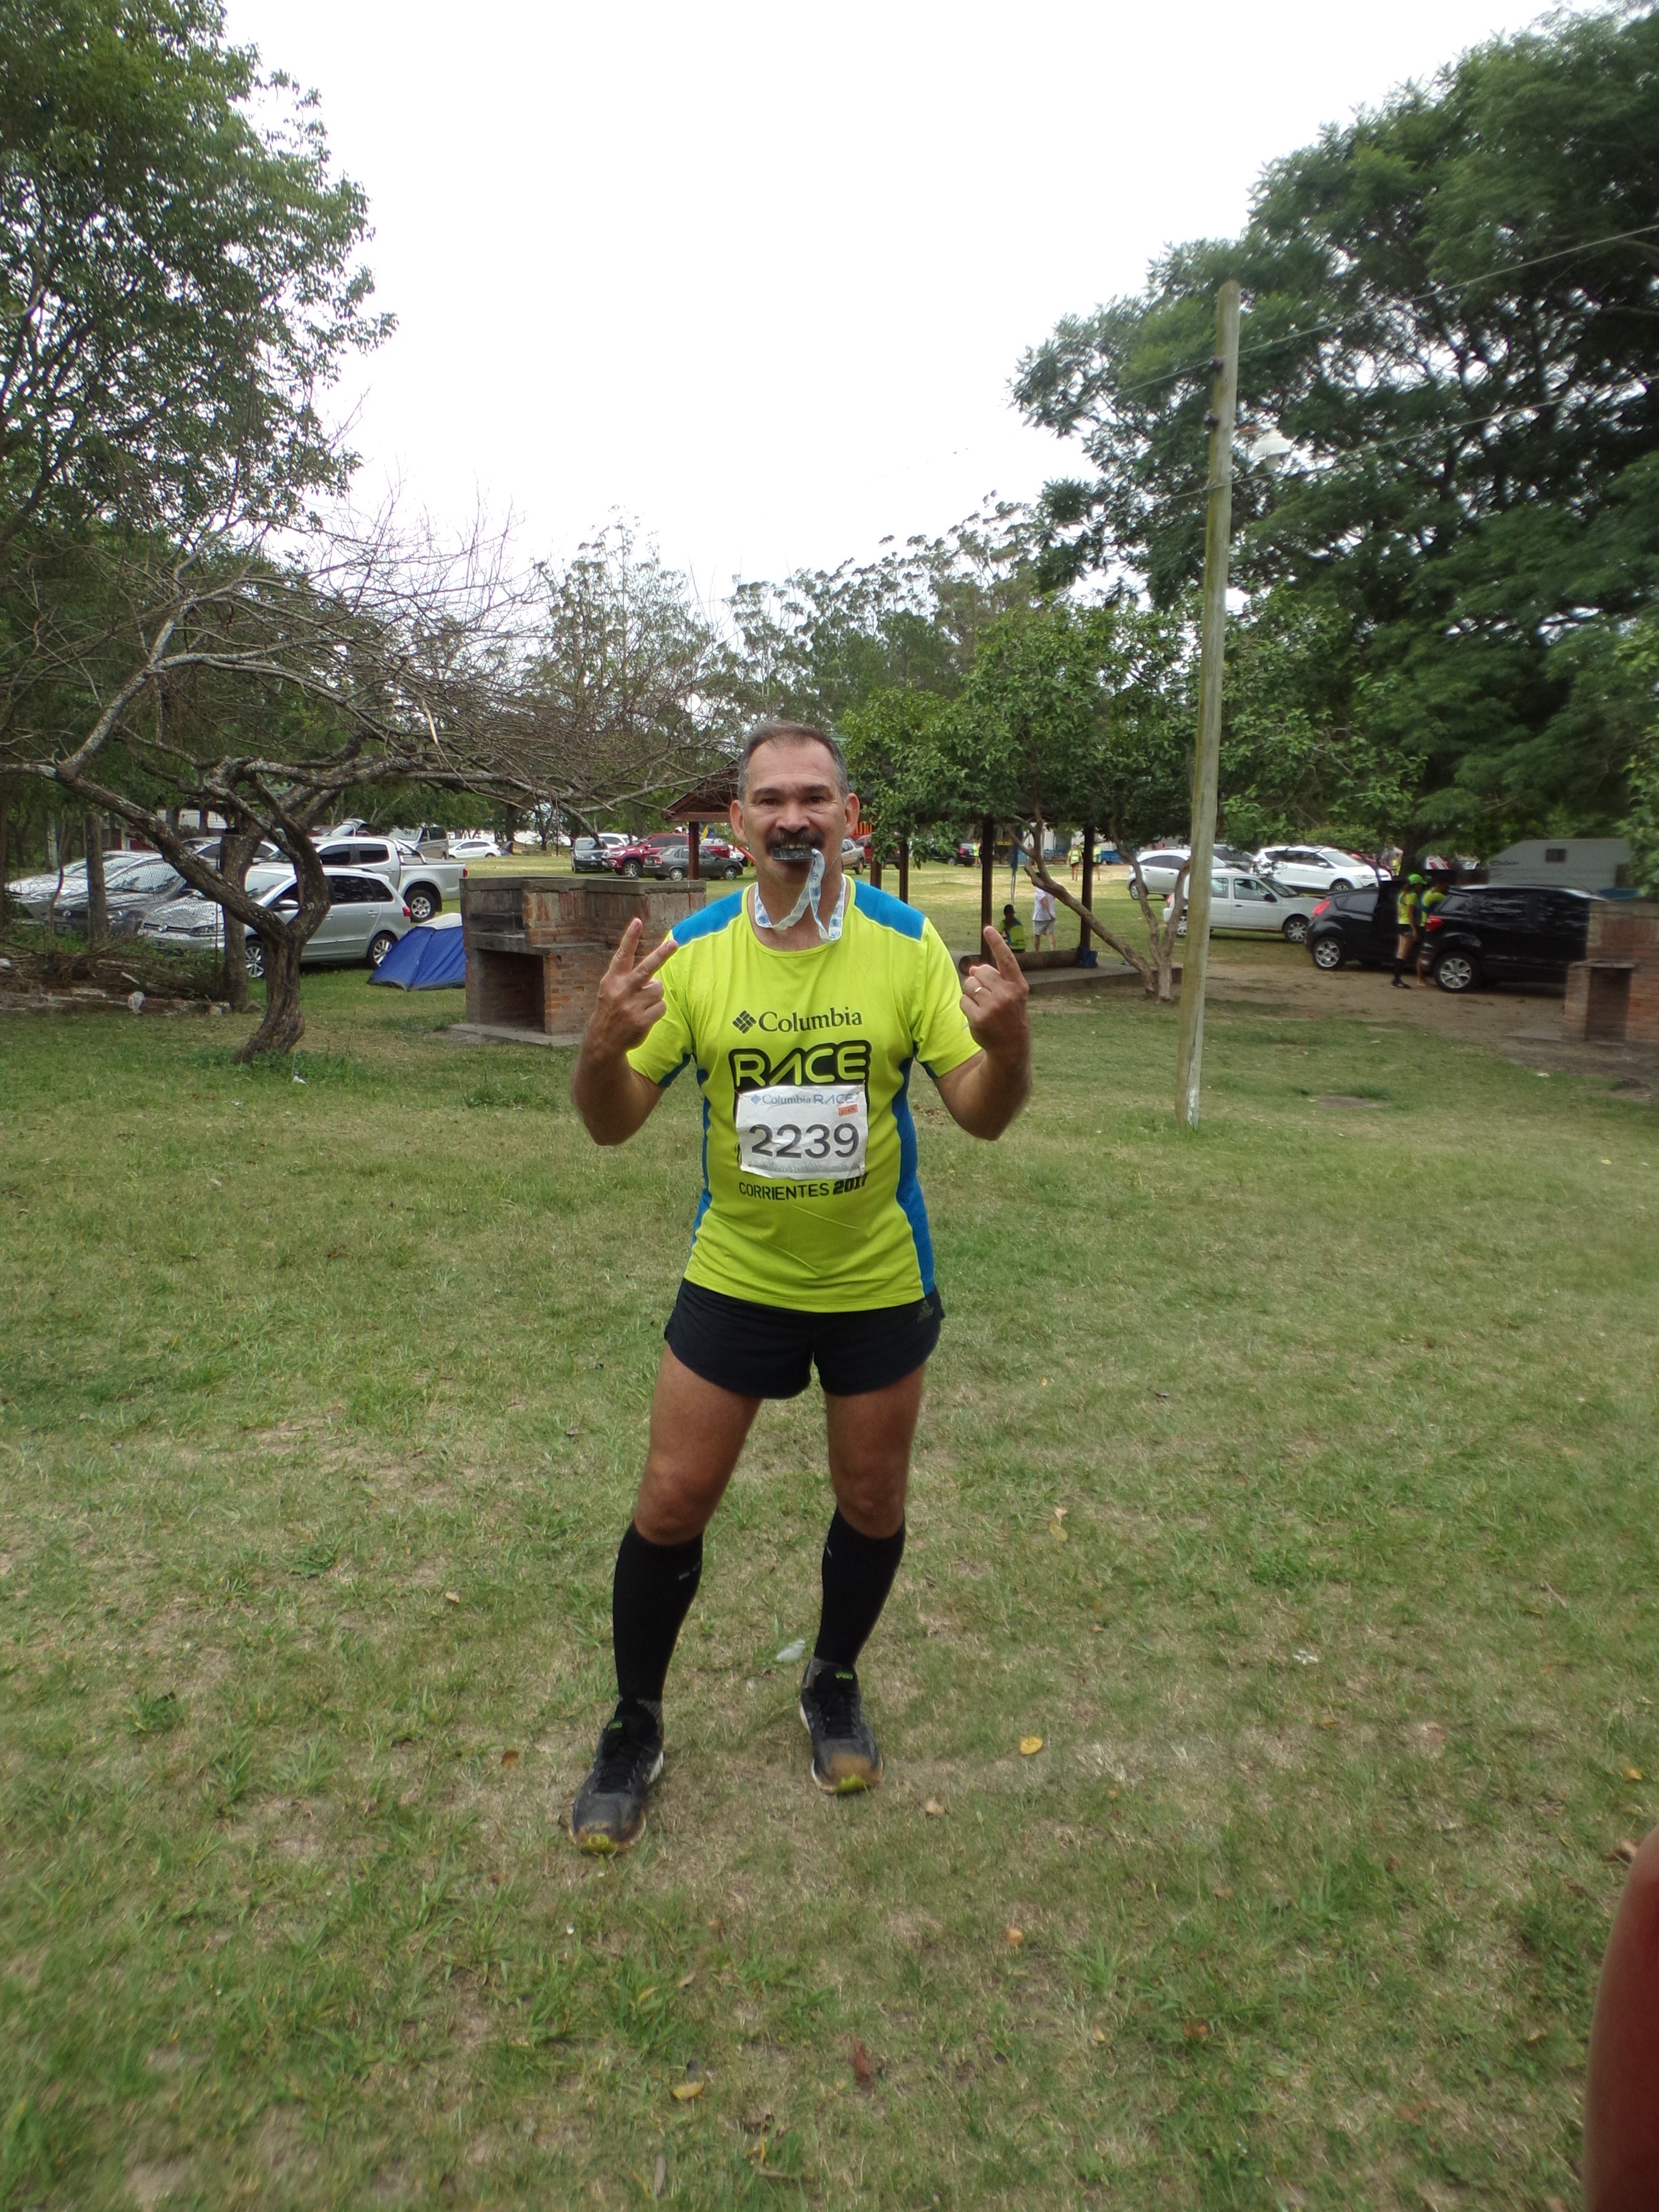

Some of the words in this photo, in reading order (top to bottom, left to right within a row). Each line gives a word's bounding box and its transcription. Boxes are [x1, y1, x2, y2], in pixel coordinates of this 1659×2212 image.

[759, 1007, 863, 1032] Columbia
[731, 1044, 868, 1087] RACE
[762, 1093, 811, 1105] Columbia
[813, 1094, 854, 1104] RACE
[749, 1123, 859, 1159] 2239
[739, 1182, 830, 1200] CORRIENTES
[833, 1172, 869, 1195] 2017
